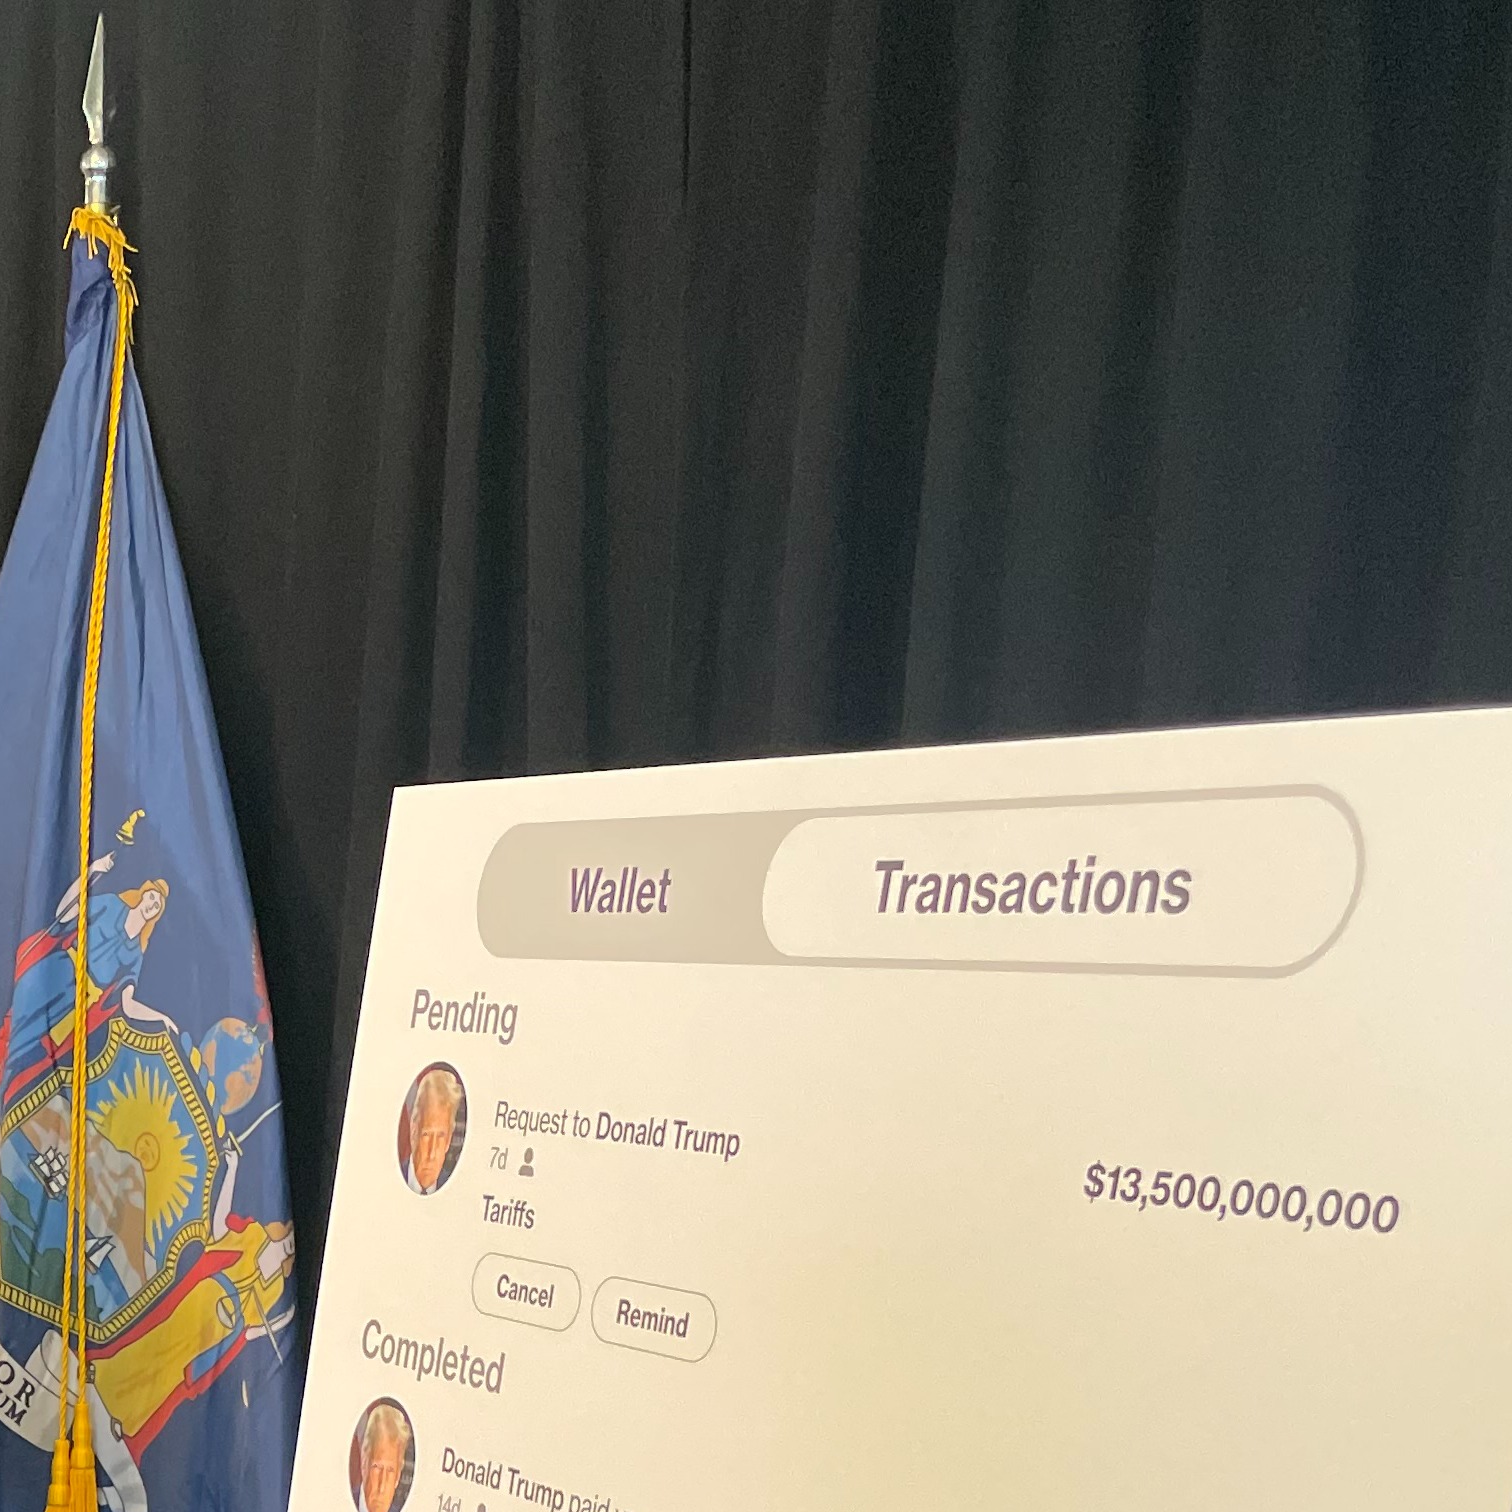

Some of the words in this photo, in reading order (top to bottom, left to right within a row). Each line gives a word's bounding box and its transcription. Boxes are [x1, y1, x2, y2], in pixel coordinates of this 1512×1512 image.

[570, 866, 672, 914] Wallet
[875, 855, 1192, 915] Transactions
[410, 989, 518, 1045] Pending
[489, 1147, 508, 1171] 7d
[495, 1101, 568, 1137] Request
[573, 1110, 590, 1138] to
[595, 1111, 666, 1148] Donald
[673, 1120, 741, 1162] Trump
[482, 1194, 535, 1229] Tariffs
[1084, 1160, 1400, 1233] $13,500,000,000
[496, 1273, 555, 1308] Cancel
[616, 1298, 690, 1338] Remind
[362, 1319, 506, 1394] Completed
[441, 1446, 503, 1490] Donald
[506, 1467, 564, 1512] Trump
